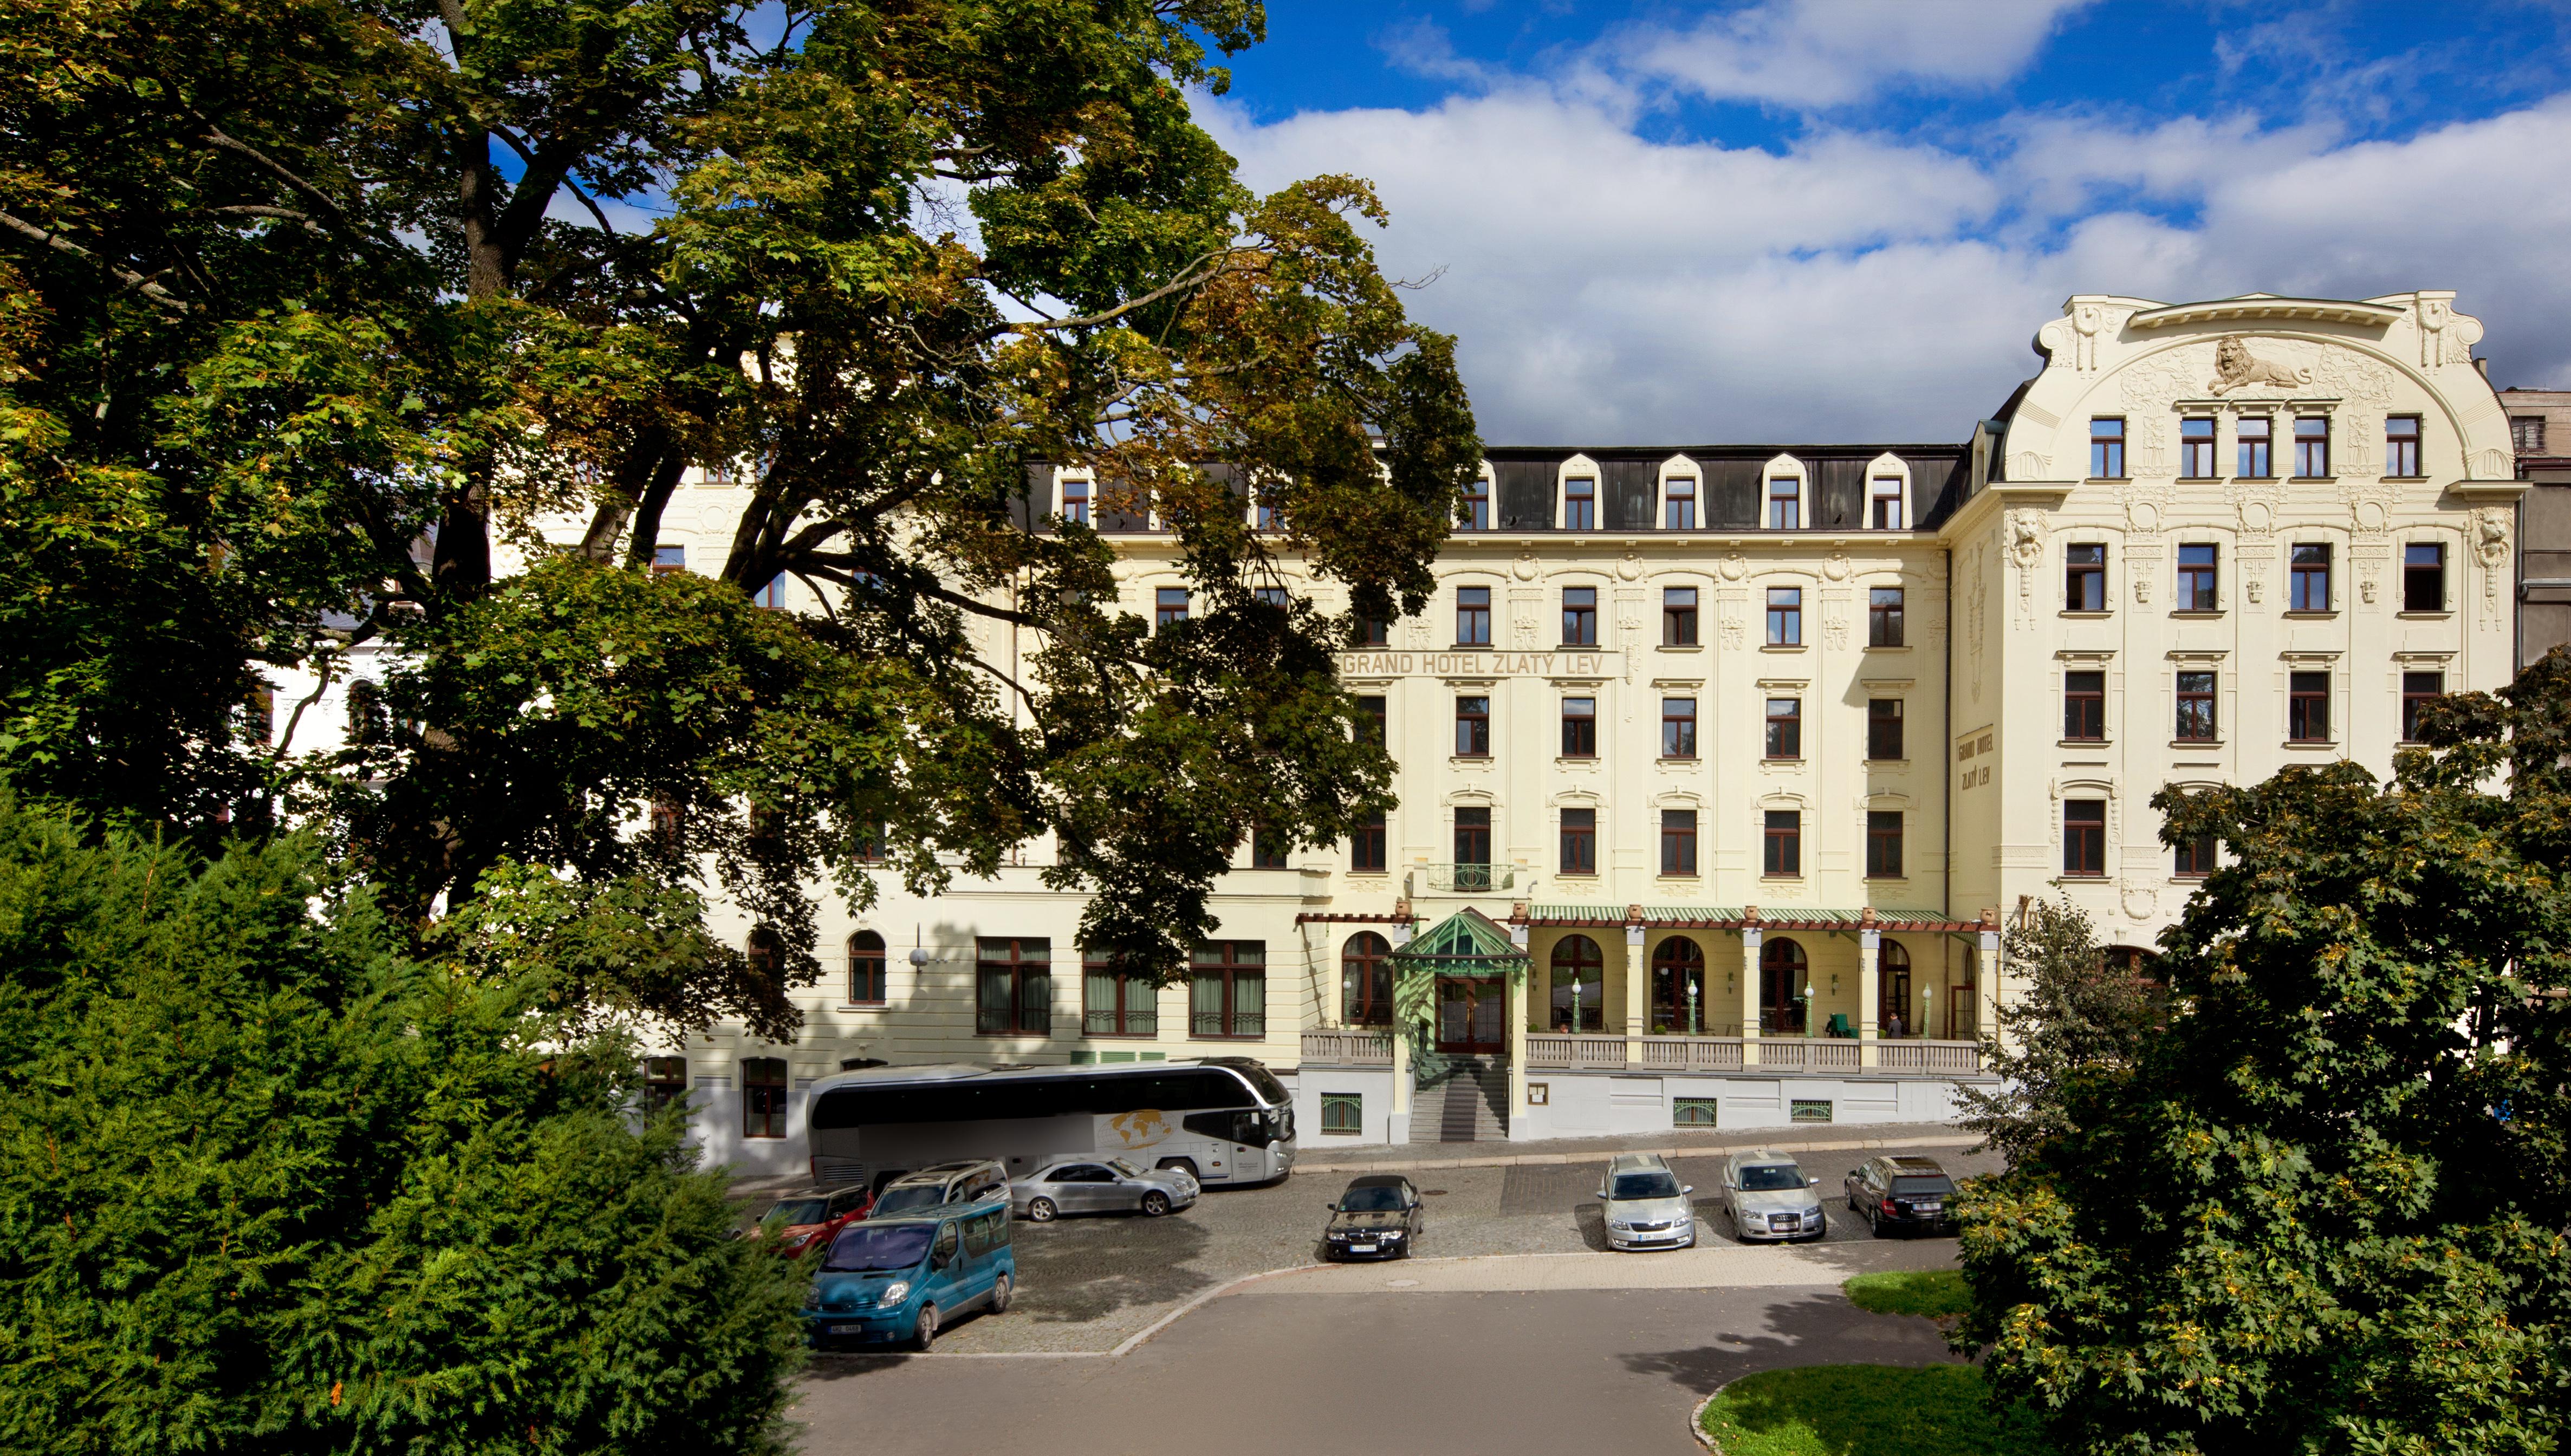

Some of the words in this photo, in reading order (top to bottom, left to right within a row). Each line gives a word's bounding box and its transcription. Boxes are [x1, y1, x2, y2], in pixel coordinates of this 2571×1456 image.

[1343, 654, 1413, 673] GRAND
[1423, 654, 1485, 673] HOTEL
[1493, 653, 1556, 674] ZLATÝ
[1566, 654, 1603, 674] LEV
[1959, 740, 1975, 762] GRAND
[1977, 733, 1994, 756] HOTEL
[1962, 764, 1977, 791] ZLATÝ
[1979, 765, 1990, 786] LEV
